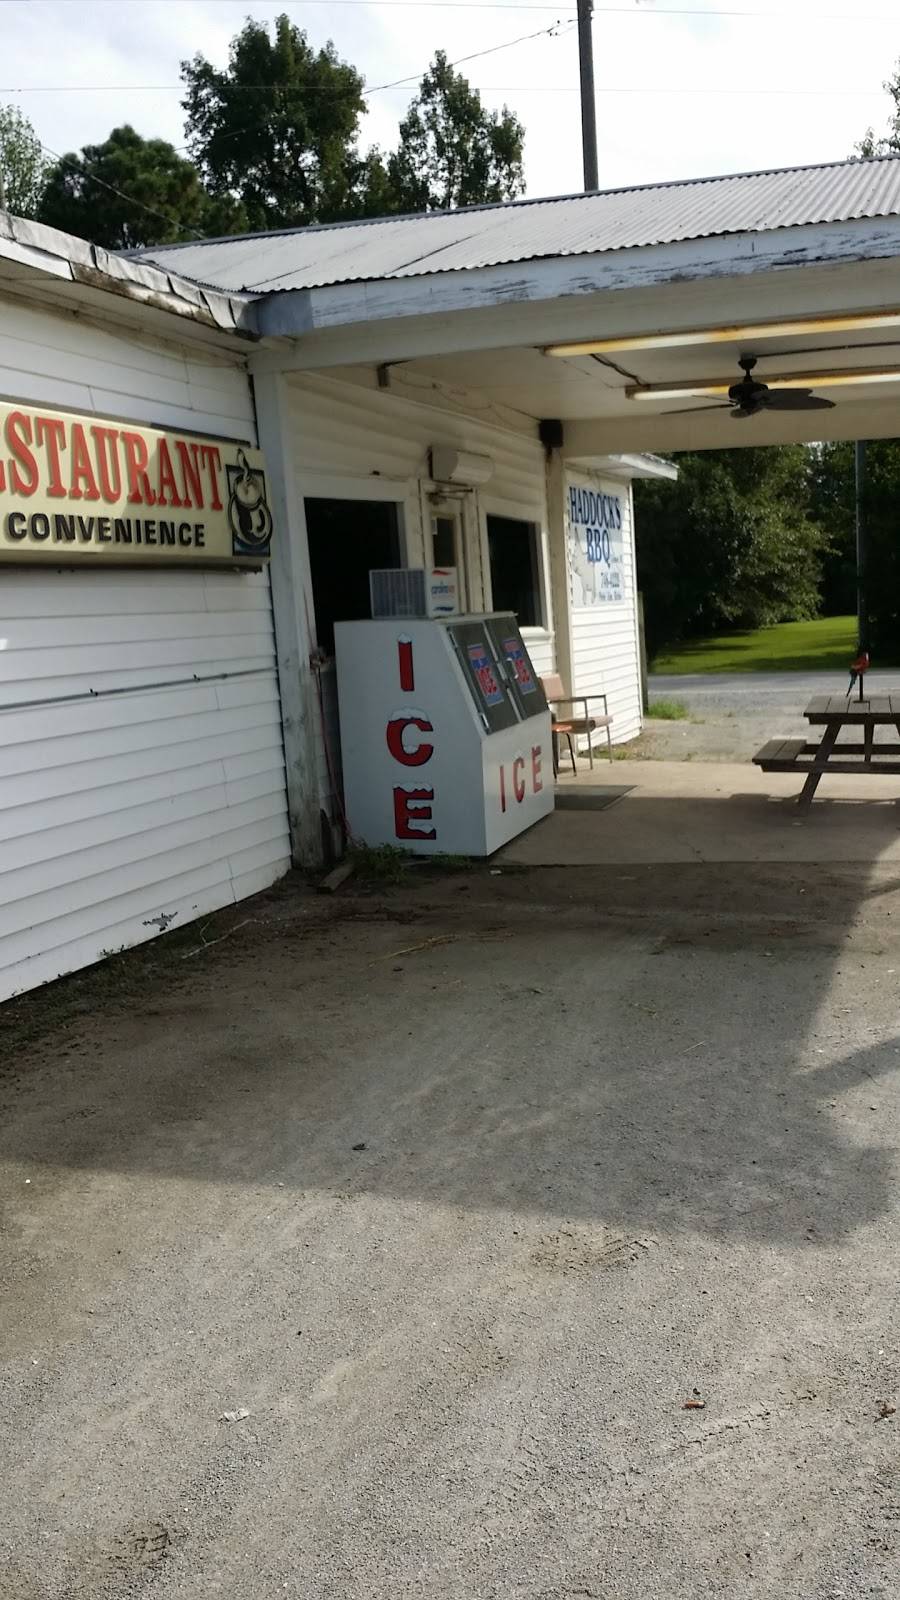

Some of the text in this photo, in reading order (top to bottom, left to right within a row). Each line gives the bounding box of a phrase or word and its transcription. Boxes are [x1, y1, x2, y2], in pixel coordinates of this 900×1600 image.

[7, 512, 205, 547] CONVENIENCE
[587, 528, 611, 568] BBQ
[386, 635, 437, 840] ICE
[499, 745, 543, 813] ICE
